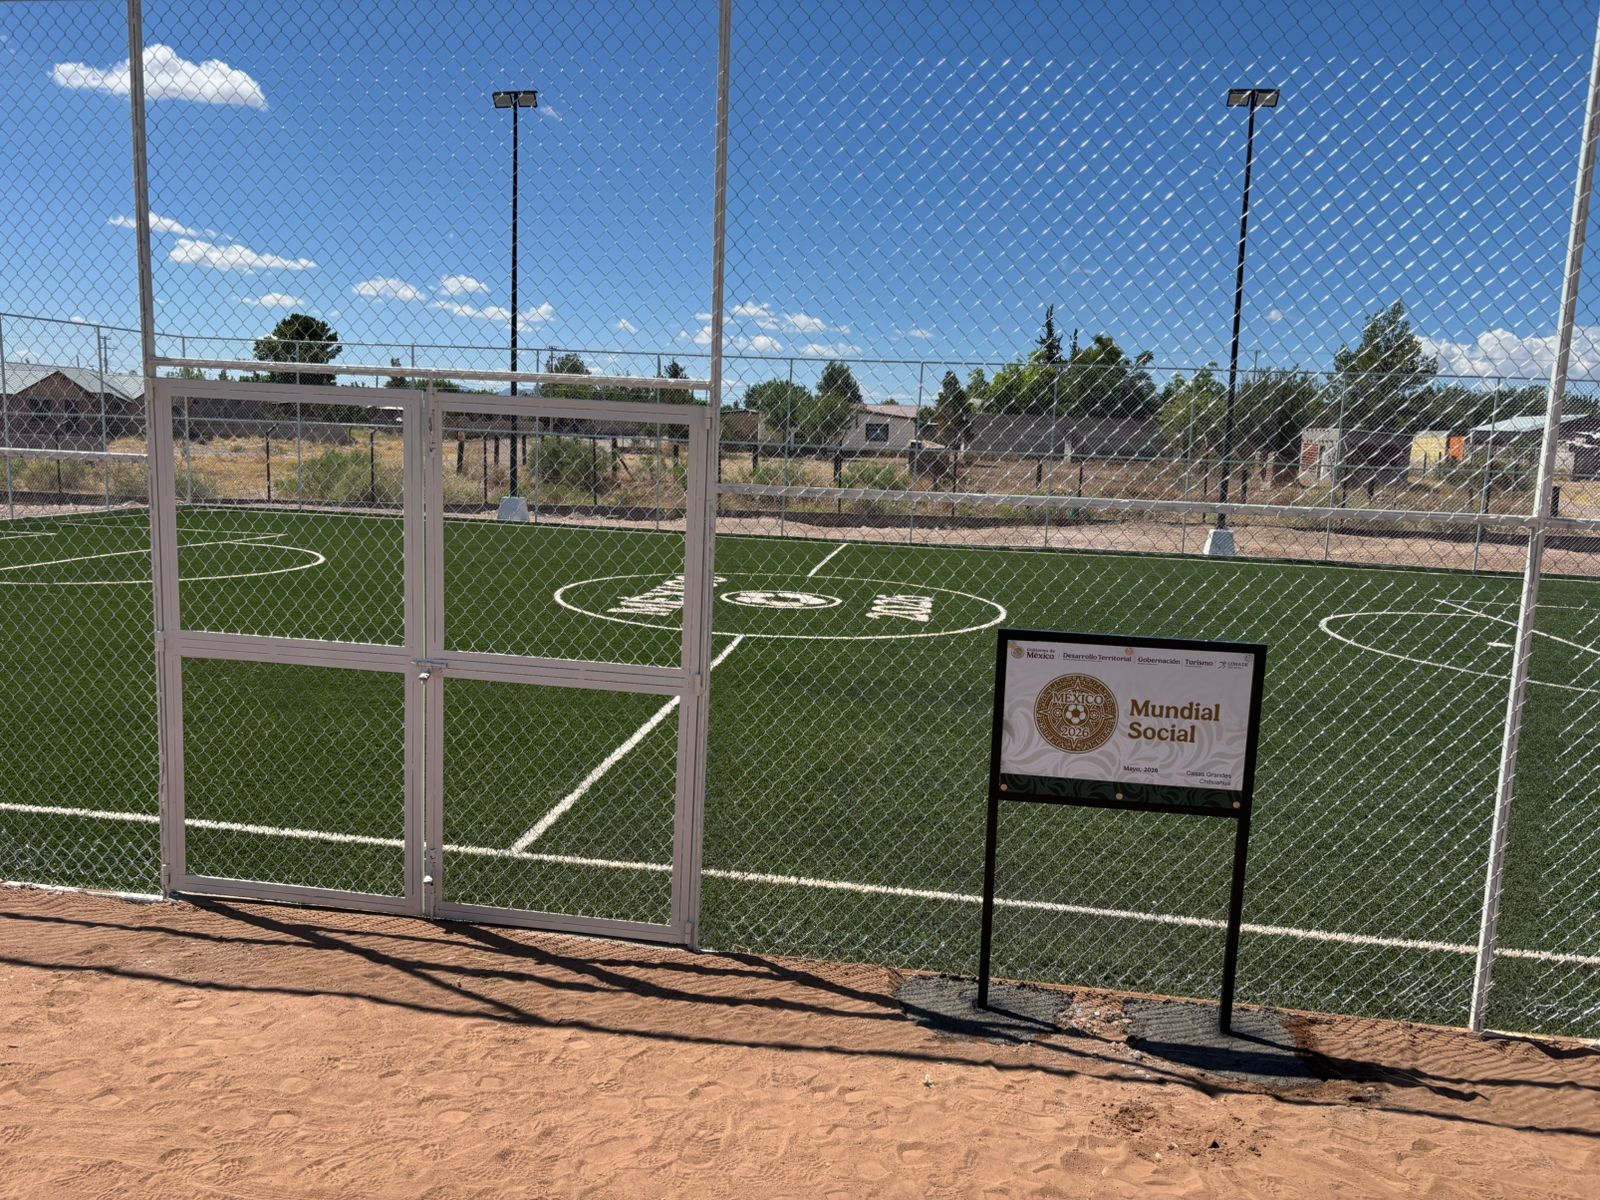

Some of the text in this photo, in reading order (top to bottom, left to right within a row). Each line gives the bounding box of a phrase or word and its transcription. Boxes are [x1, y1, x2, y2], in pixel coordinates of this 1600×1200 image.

[1026, 651, 1055, 660] México
[1063, 652, 1132, 663] Desarrollo Territorial
[1137, 656, 1181, 665] Gobernación
[1185, 658, 1214, 667] Turismo
[1051, 689, 1104, 706] MÉXICO
[1130, 698, 1220, 722] Mundial
[1061, 726, 1090, 738] 2026
[1128, 721, 1196, 744] Social
[1123, 765, 1141, 773] Mayo,
[1186, 769, 1232, 779] Casas Grandes
[1198, 777, 1231, 786] Chihuahua
